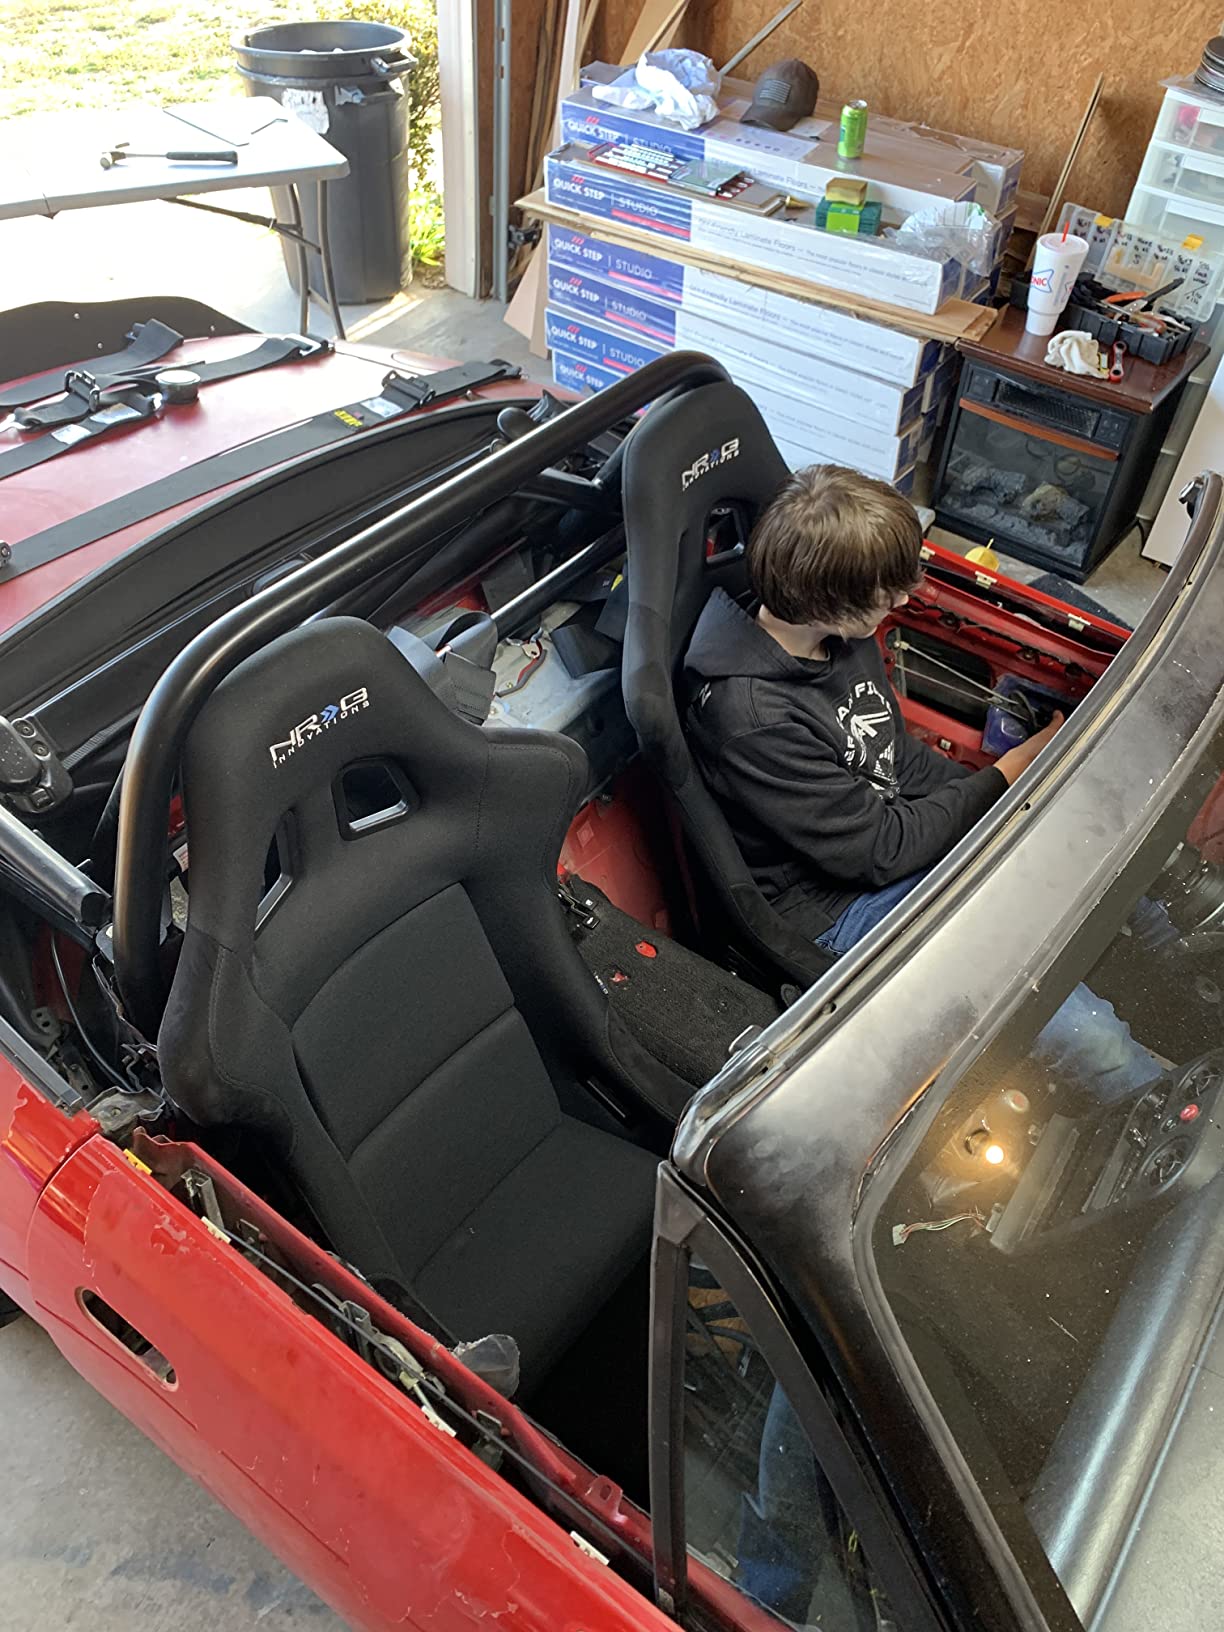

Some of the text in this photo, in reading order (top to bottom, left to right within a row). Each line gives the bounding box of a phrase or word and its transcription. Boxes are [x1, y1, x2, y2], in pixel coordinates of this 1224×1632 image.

[553, 178, 582, 194] QUICK
[583, 186, 606, 201] STEP
[618, 197, 659, 216] STUDIO
[553, 238, 581, 255] QUICK
[583, 248, 603, 262] STEP
[615, 258, 653, 279] STUDIO
[552, 279, 580, 296] QUICK
[580, 288, 600, 303] STEP
[611, 301, 647, 321] STUDIO
[551, 325, 577, 344] QUICK
[578, 336, 598, 350] STEP
[609, 347, 645, 367] STUDIO
[559, 364, 605, 389] QUICK STEP
[272, 700, 370, 769] INNOVATIONS
